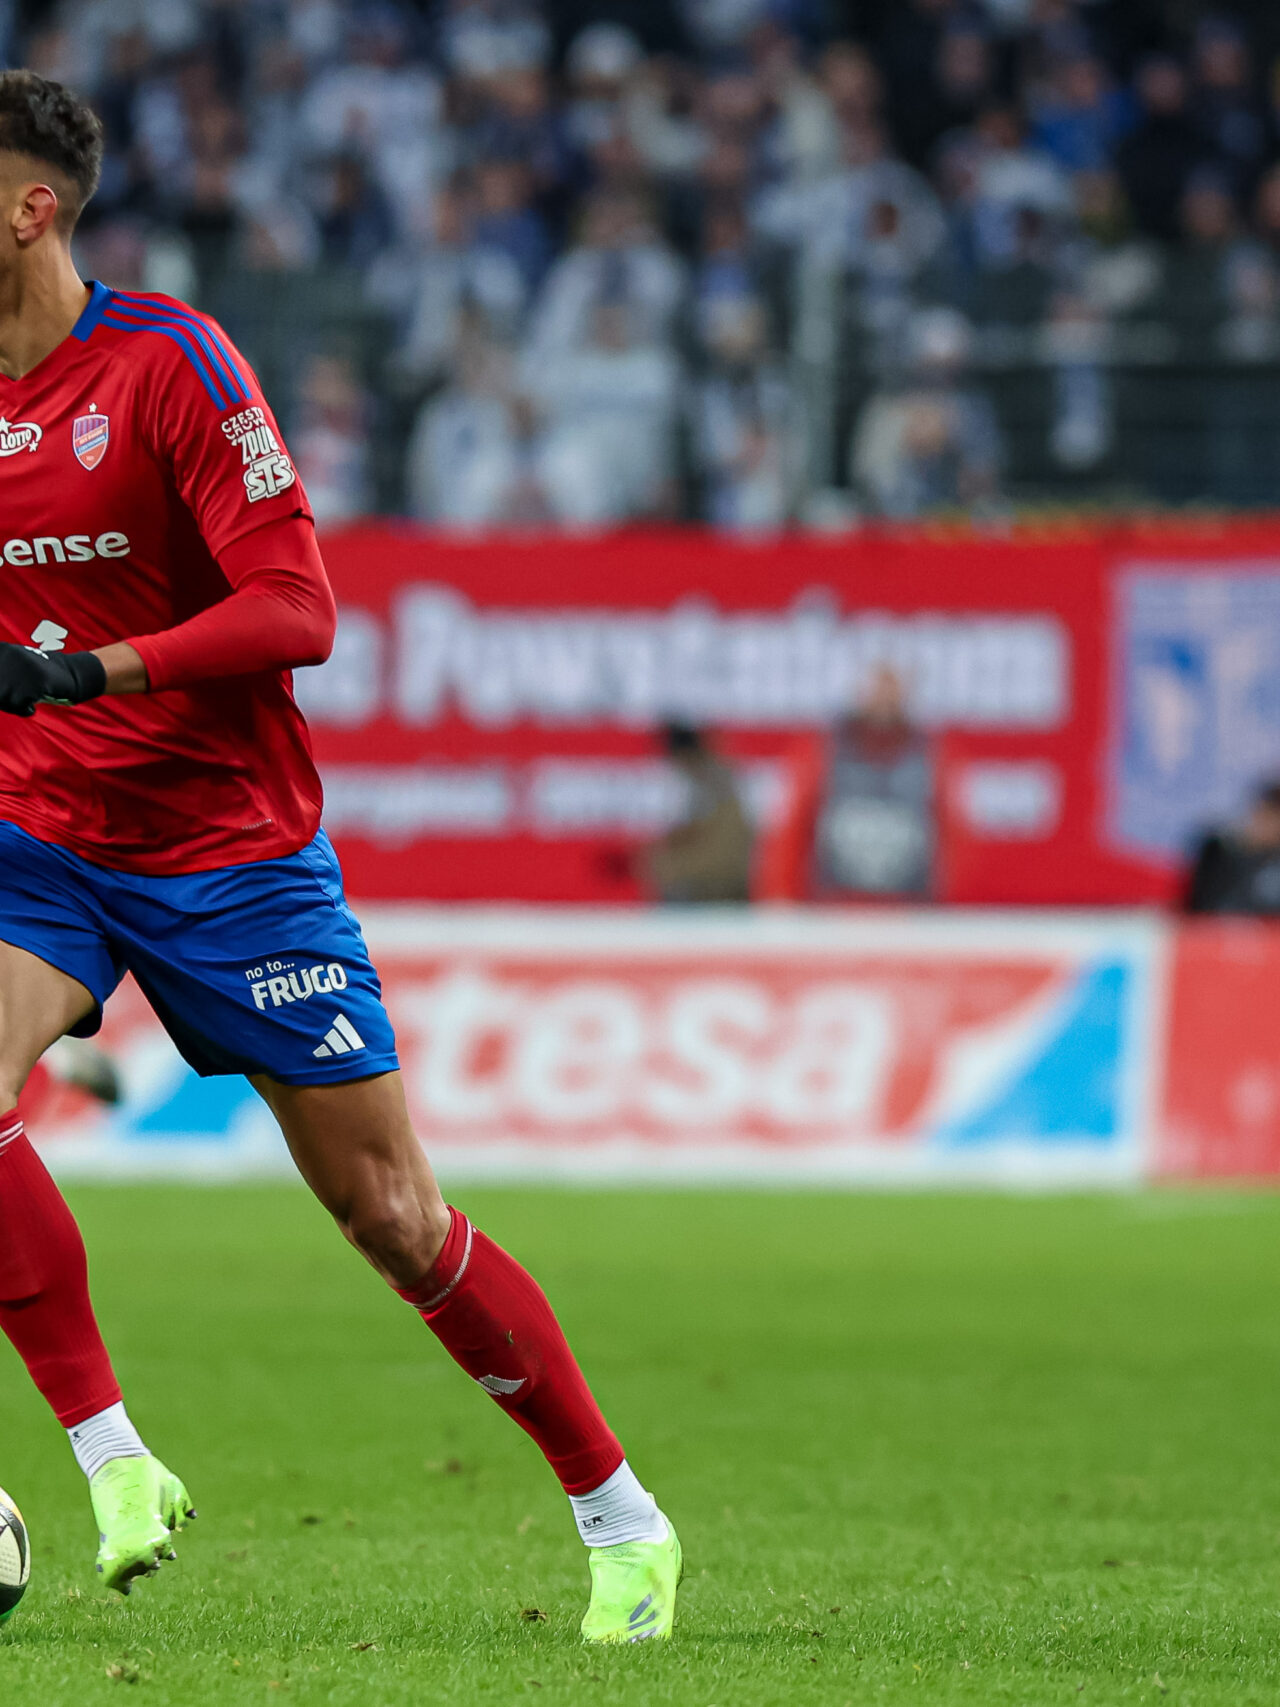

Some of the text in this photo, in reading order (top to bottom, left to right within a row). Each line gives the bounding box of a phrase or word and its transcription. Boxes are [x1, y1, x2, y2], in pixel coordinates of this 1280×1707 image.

[1, 428, 32, 449] LOTTO
[244, 452, 295, 502] STS
[245, 967, 263, 980] no
[250, 963, 347, 1010] FRUGO
[406, 964, 890, 1126] tesa
